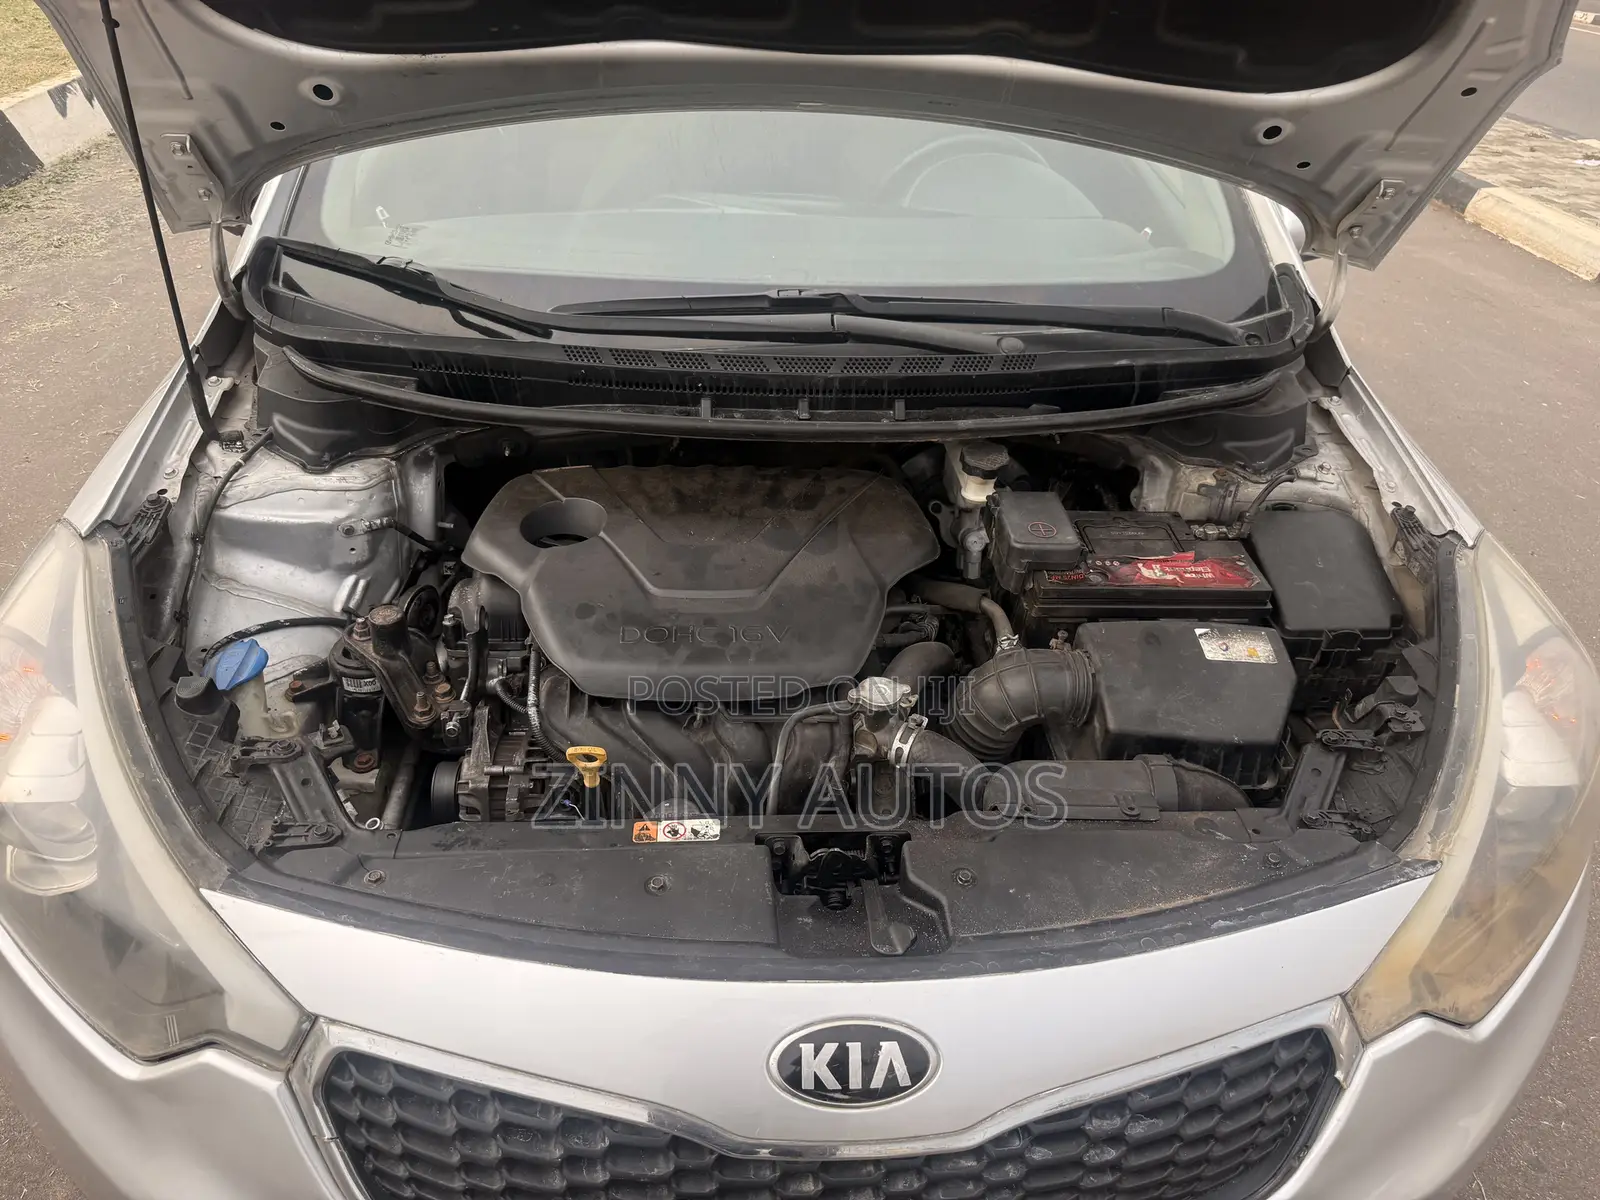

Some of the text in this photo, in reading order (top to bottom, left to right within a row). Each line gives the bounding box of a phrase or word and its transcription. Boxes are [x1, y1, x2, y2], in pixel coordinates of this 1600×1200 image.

[619, 625, 790, 643] DOHC 16V
[799, 1041, 911, 1090] KIA
